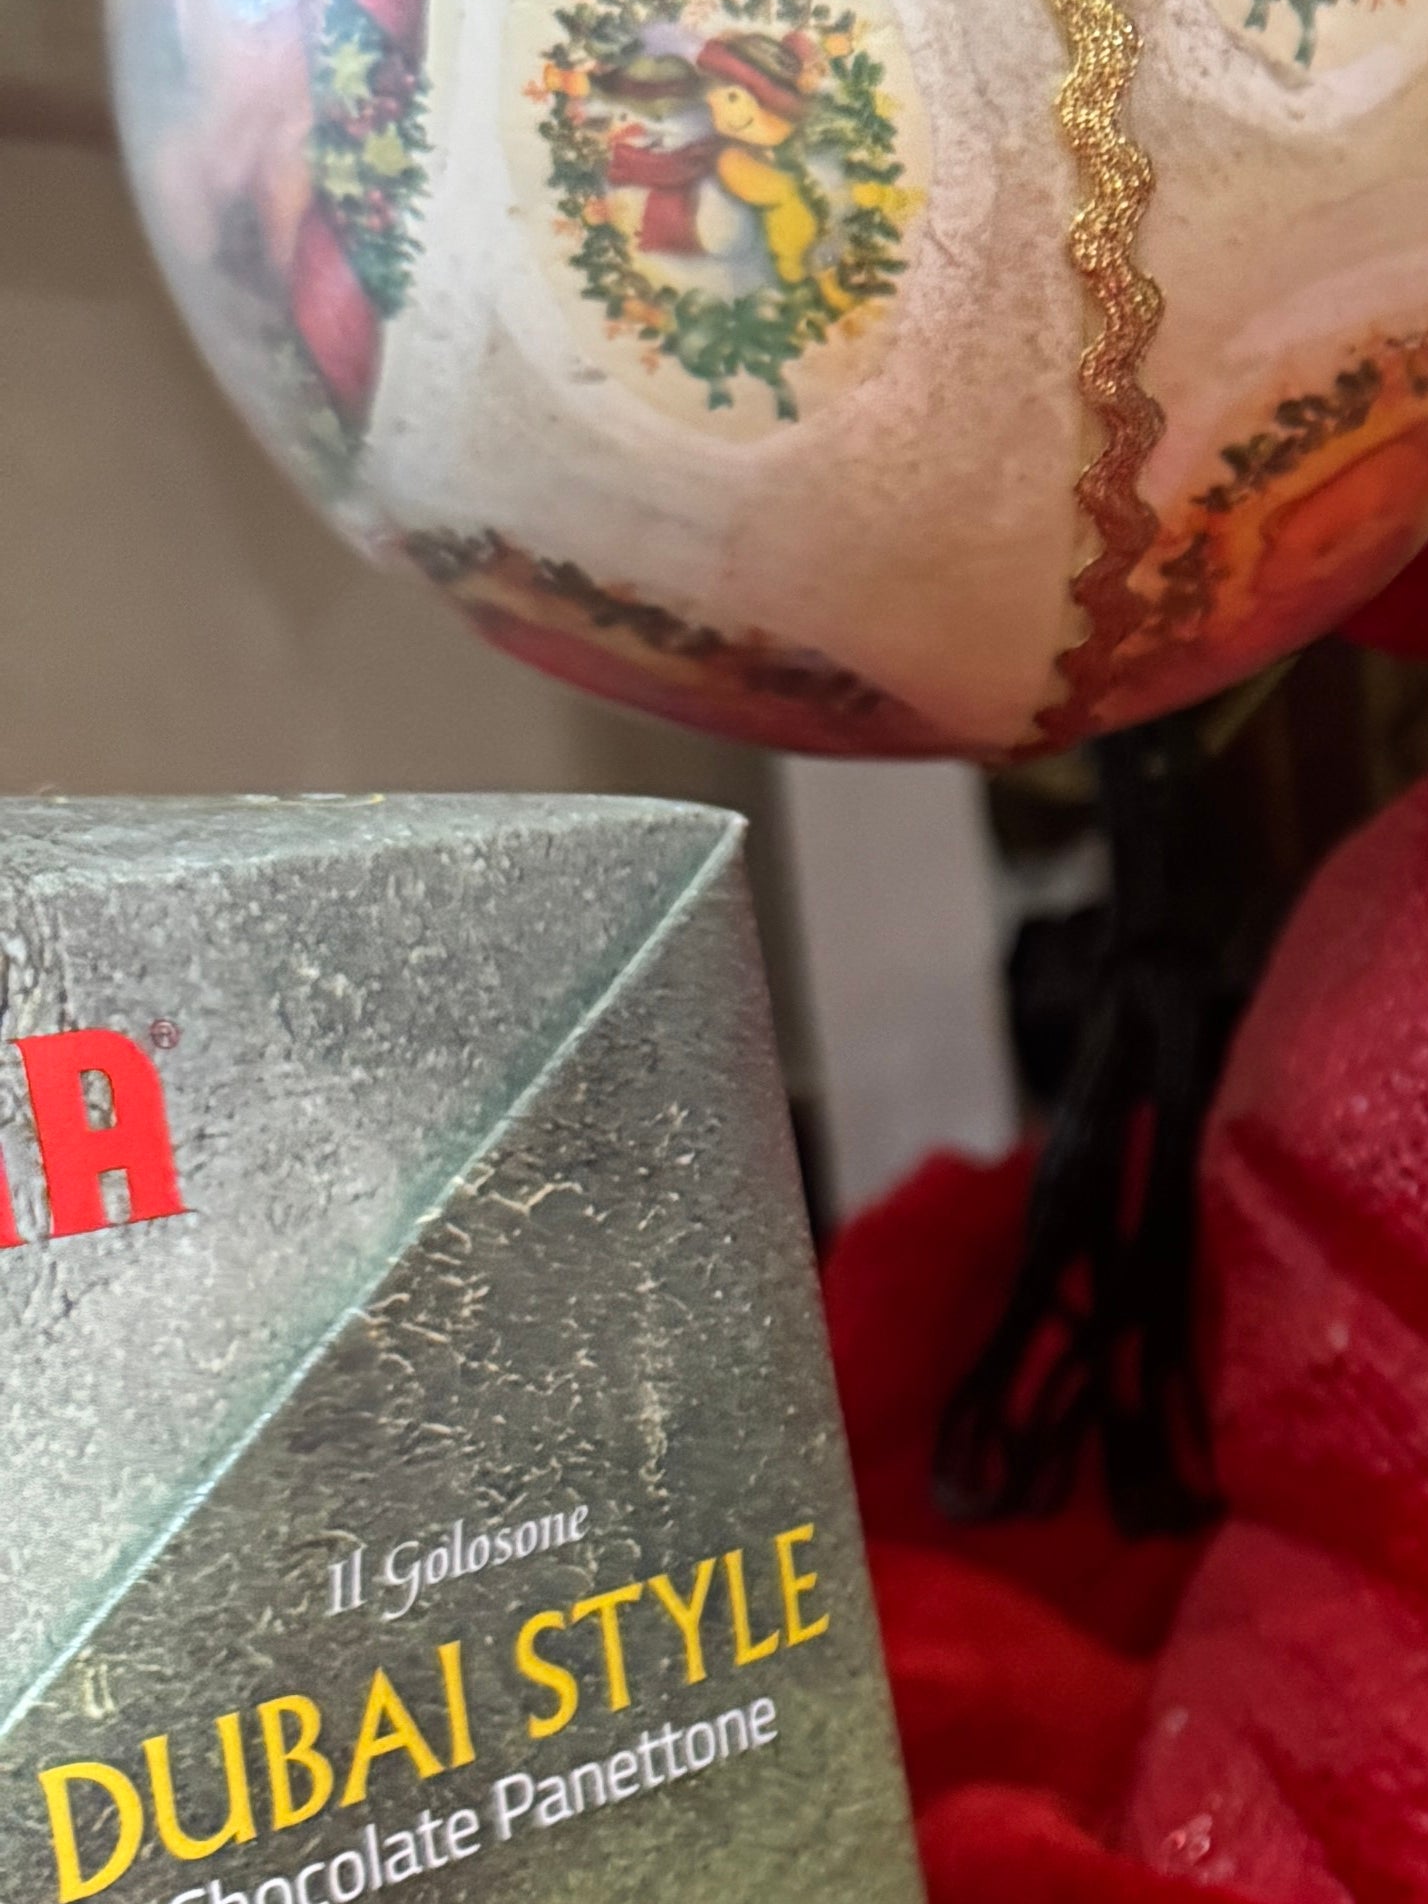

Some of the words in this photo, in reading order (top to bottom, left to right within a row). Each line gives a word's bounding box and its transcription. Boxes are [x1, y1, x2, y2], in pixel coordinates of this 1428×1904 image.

[0, 1027, 197, 1252] A
[325, 1542, 368, 1617] Il
[380, 1504, 590, 1622] Golosone
[37, 1640, 477, 1904] DUBAI
[514, 1522, 830, 1739] STYLE
[492, 1696, 779, 1841] Panettone
